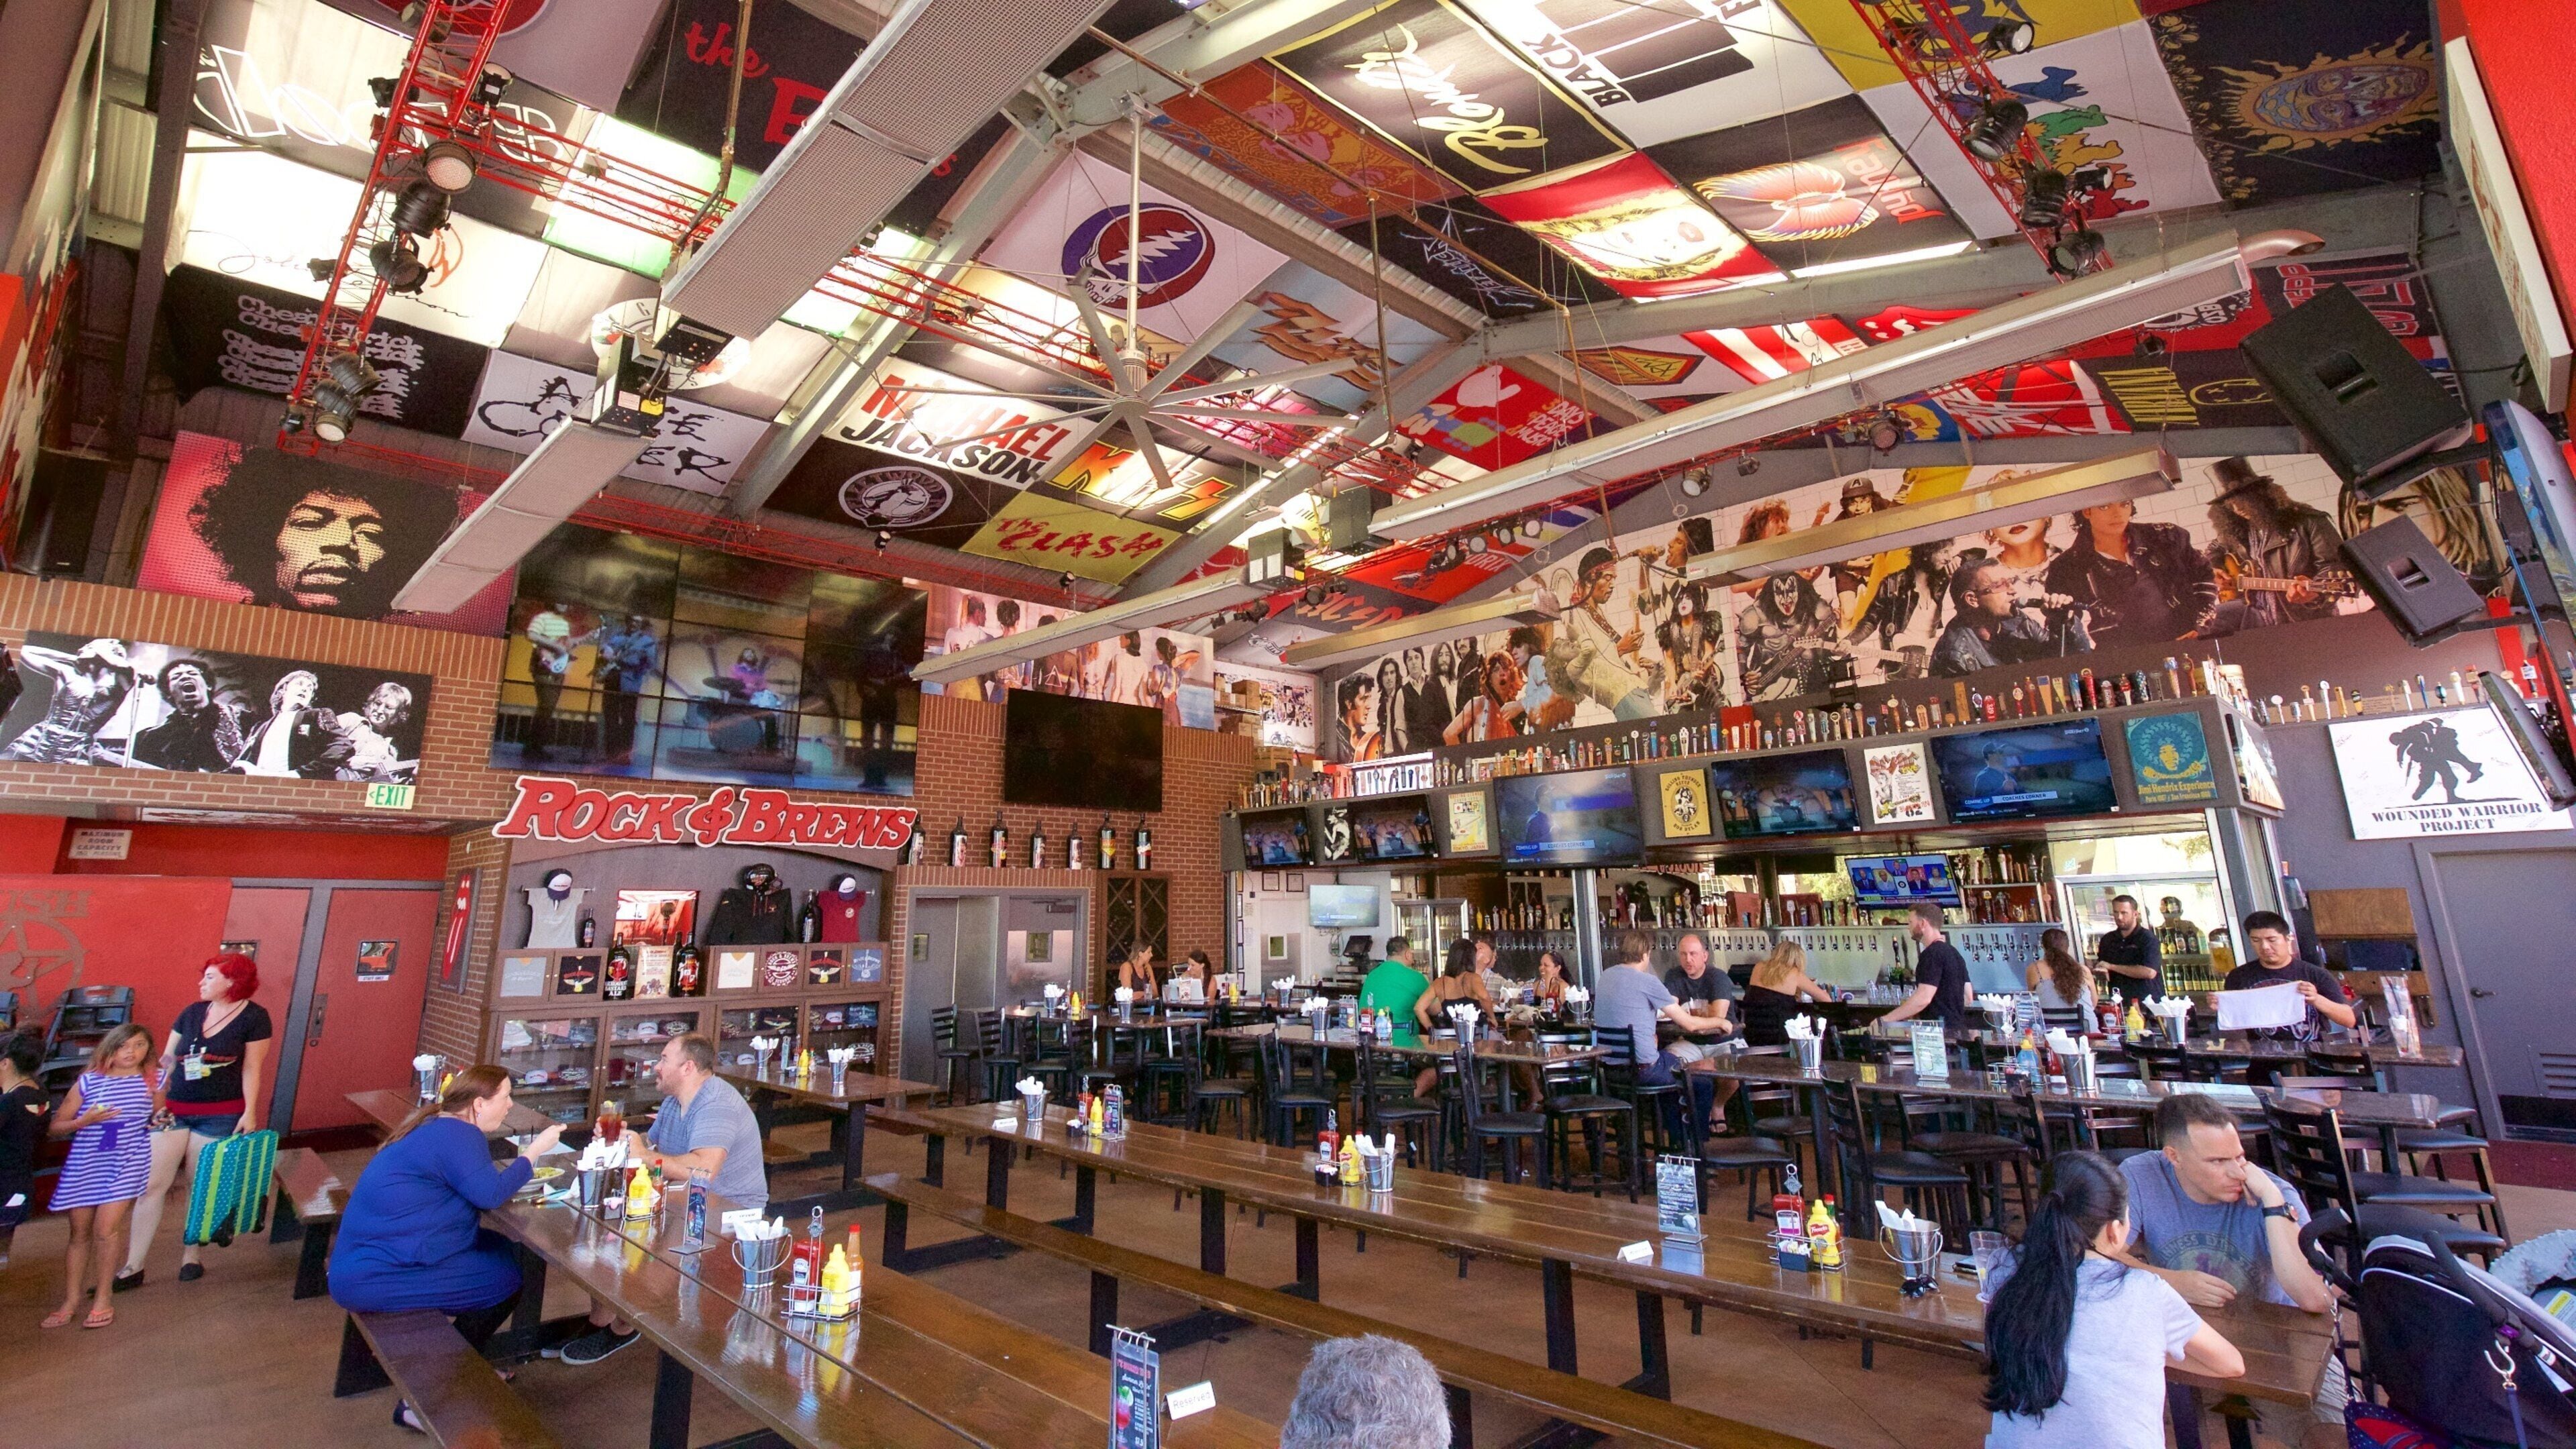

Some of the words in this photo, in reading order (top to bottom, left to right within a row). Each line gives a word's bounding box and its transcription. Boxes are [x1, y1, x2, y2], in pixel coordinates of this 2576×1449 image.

[685, 22, 769, 78] the
[1521, 33, 1631, 107] BLACK
[1344, 22, 1550, 174] Blondie
[2098, 366, 2200, 427] NIRVANA
[840, 417, 1046, 484] JACKSON
[996, 529, 1166, 559] CLASH
[375, 785, 409, 806] EXIT
[2138, 784, 2152, 794] Jimi
[2152, 782, 2179, 792] Hendrix
[2178, 780, 2215, 792] Experience
[496, 779, 692, 841] ROCK
[690, 788, 735, 845] &
[725, 790, 915, 849] BREWS
[2372, 806, 2453, 822] WOUNDED
[2458, 802, 2542, 818] WARRIOR
[2420, 819, 2496, 833] PROJECT
[1172, 1391, 1212, 1409] Reserved
